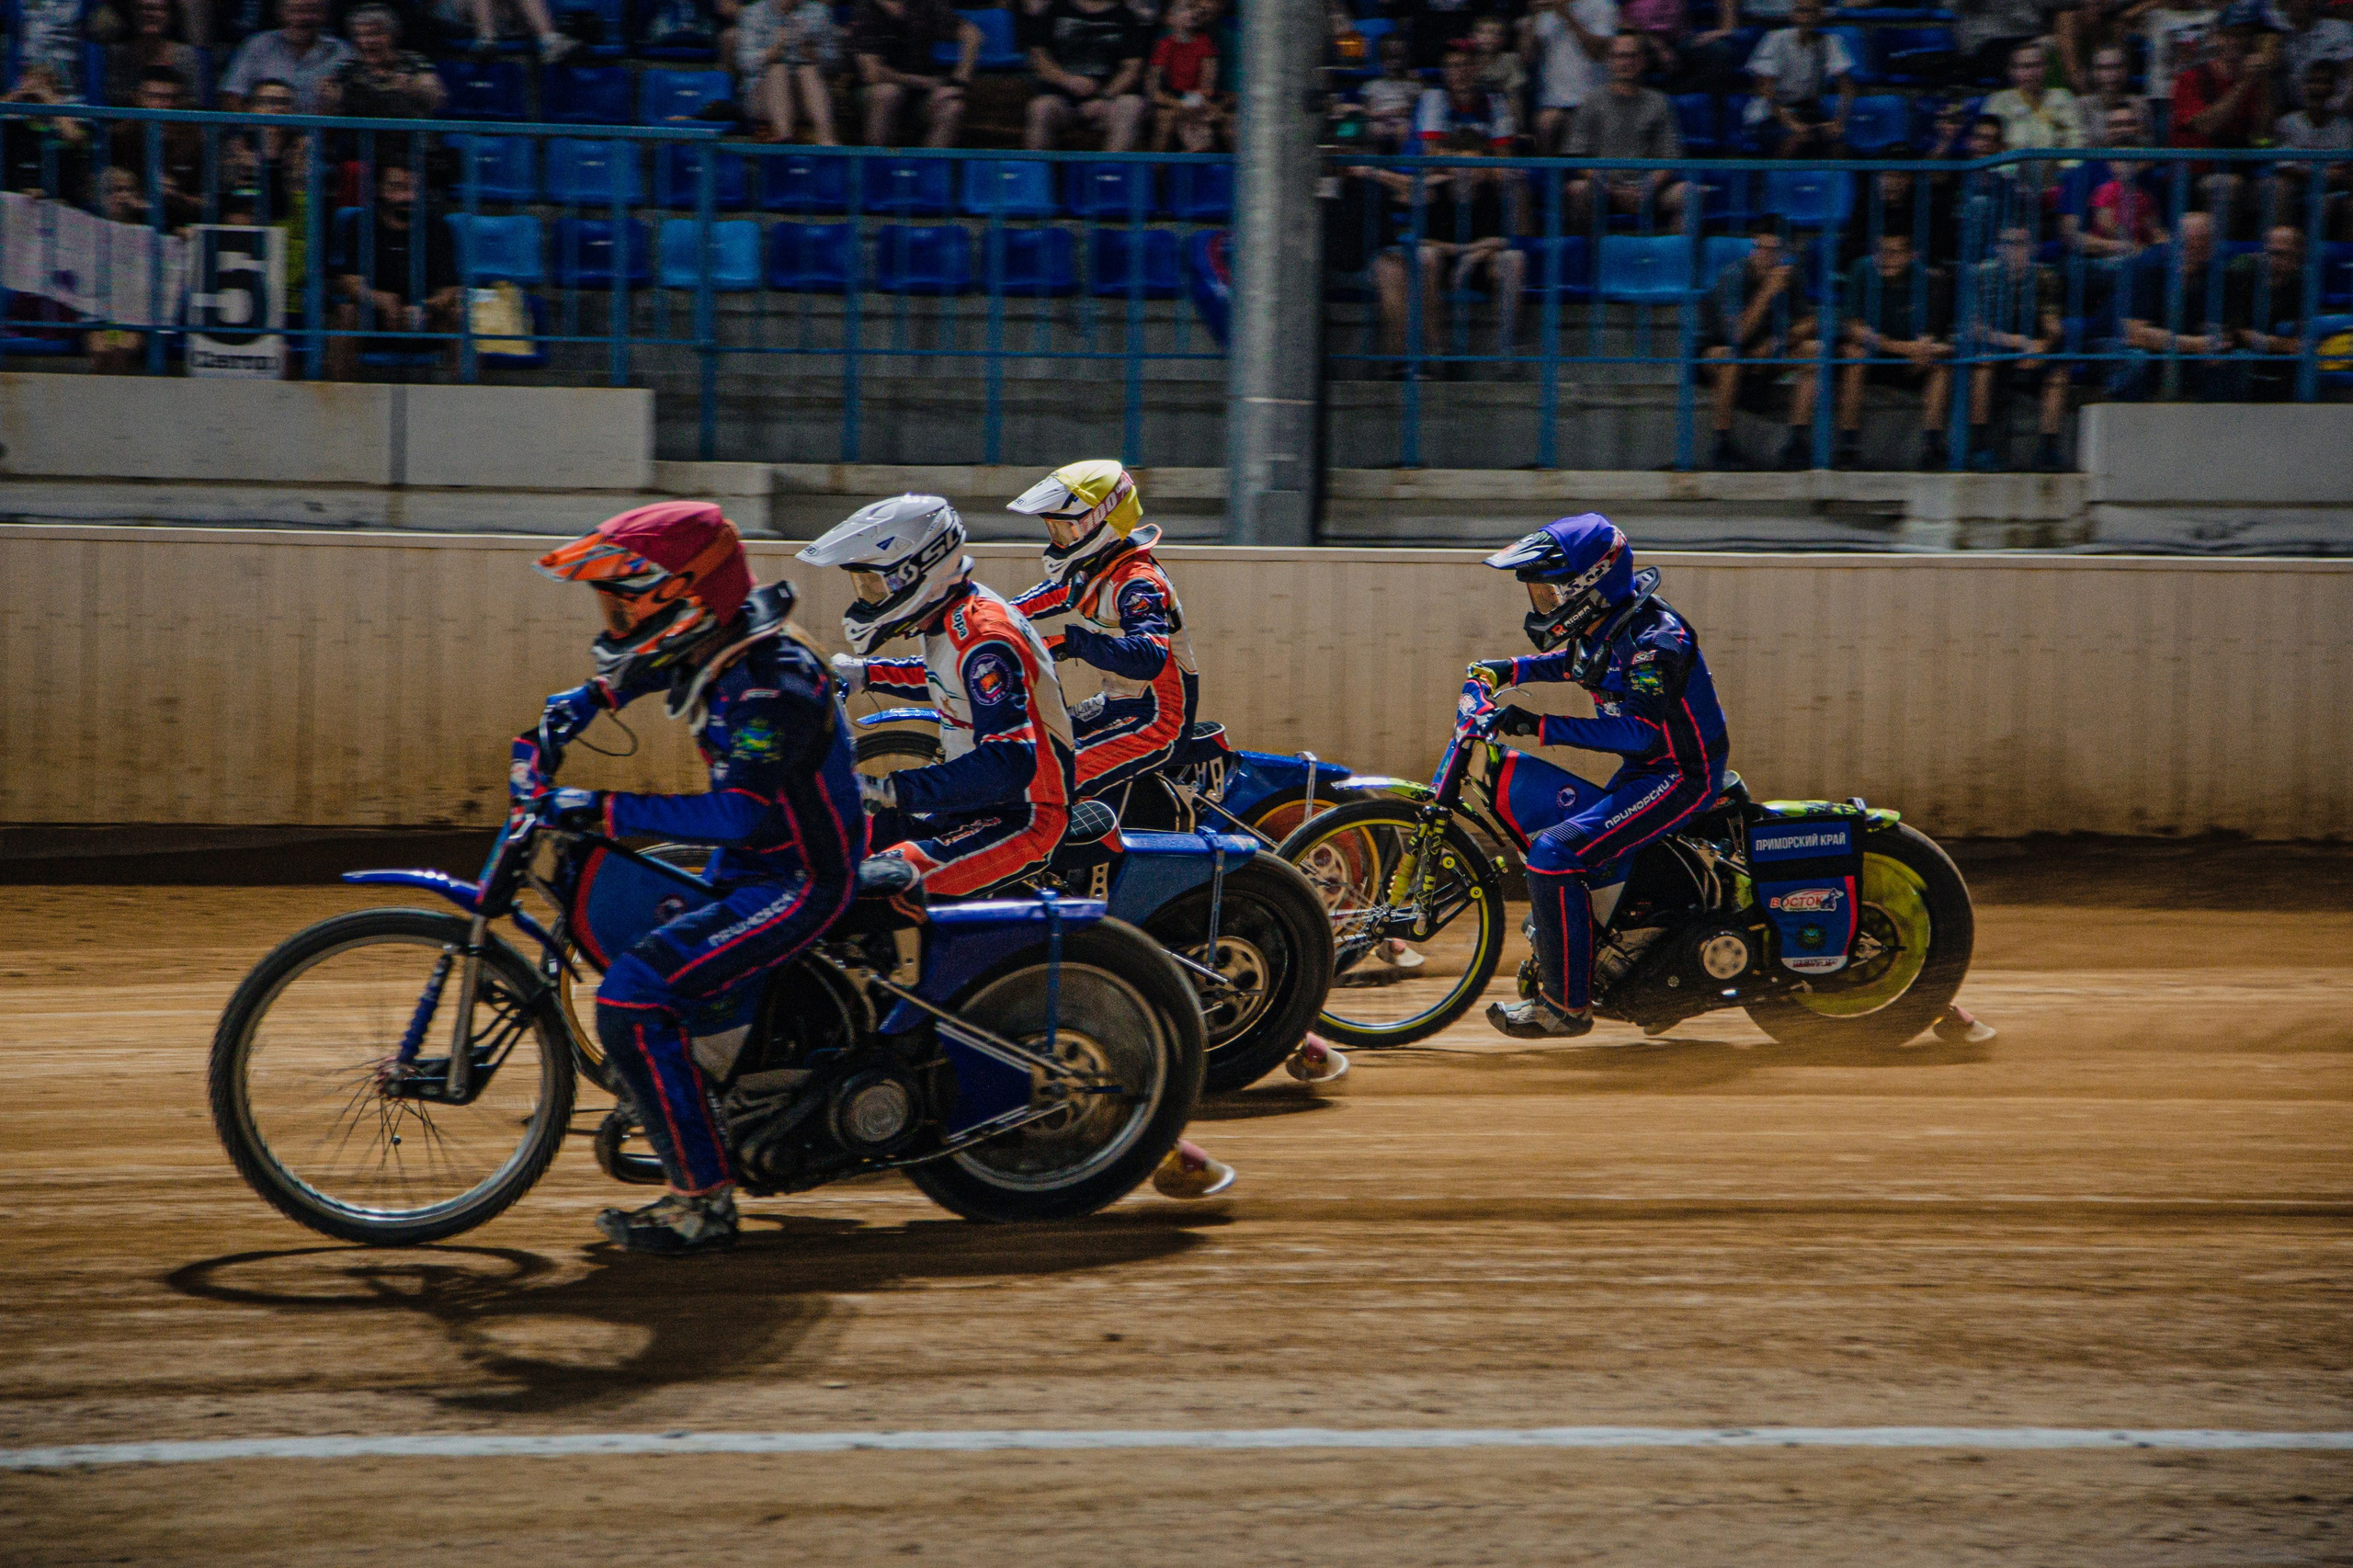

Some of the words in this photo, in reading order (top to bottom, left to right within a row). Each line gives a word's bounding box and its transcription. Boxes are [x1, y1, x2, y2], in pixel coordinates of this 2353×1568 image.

[199, 230, 267, 346] 5
[1564, 605, 1592, 628] RIDER
[1756, 834, 1818, 851] ПРИМОРСКИЙ
[1820, 832, 1846, 846] КРАЙ
[1769, 895, 1824, 909] ВОСТОК
